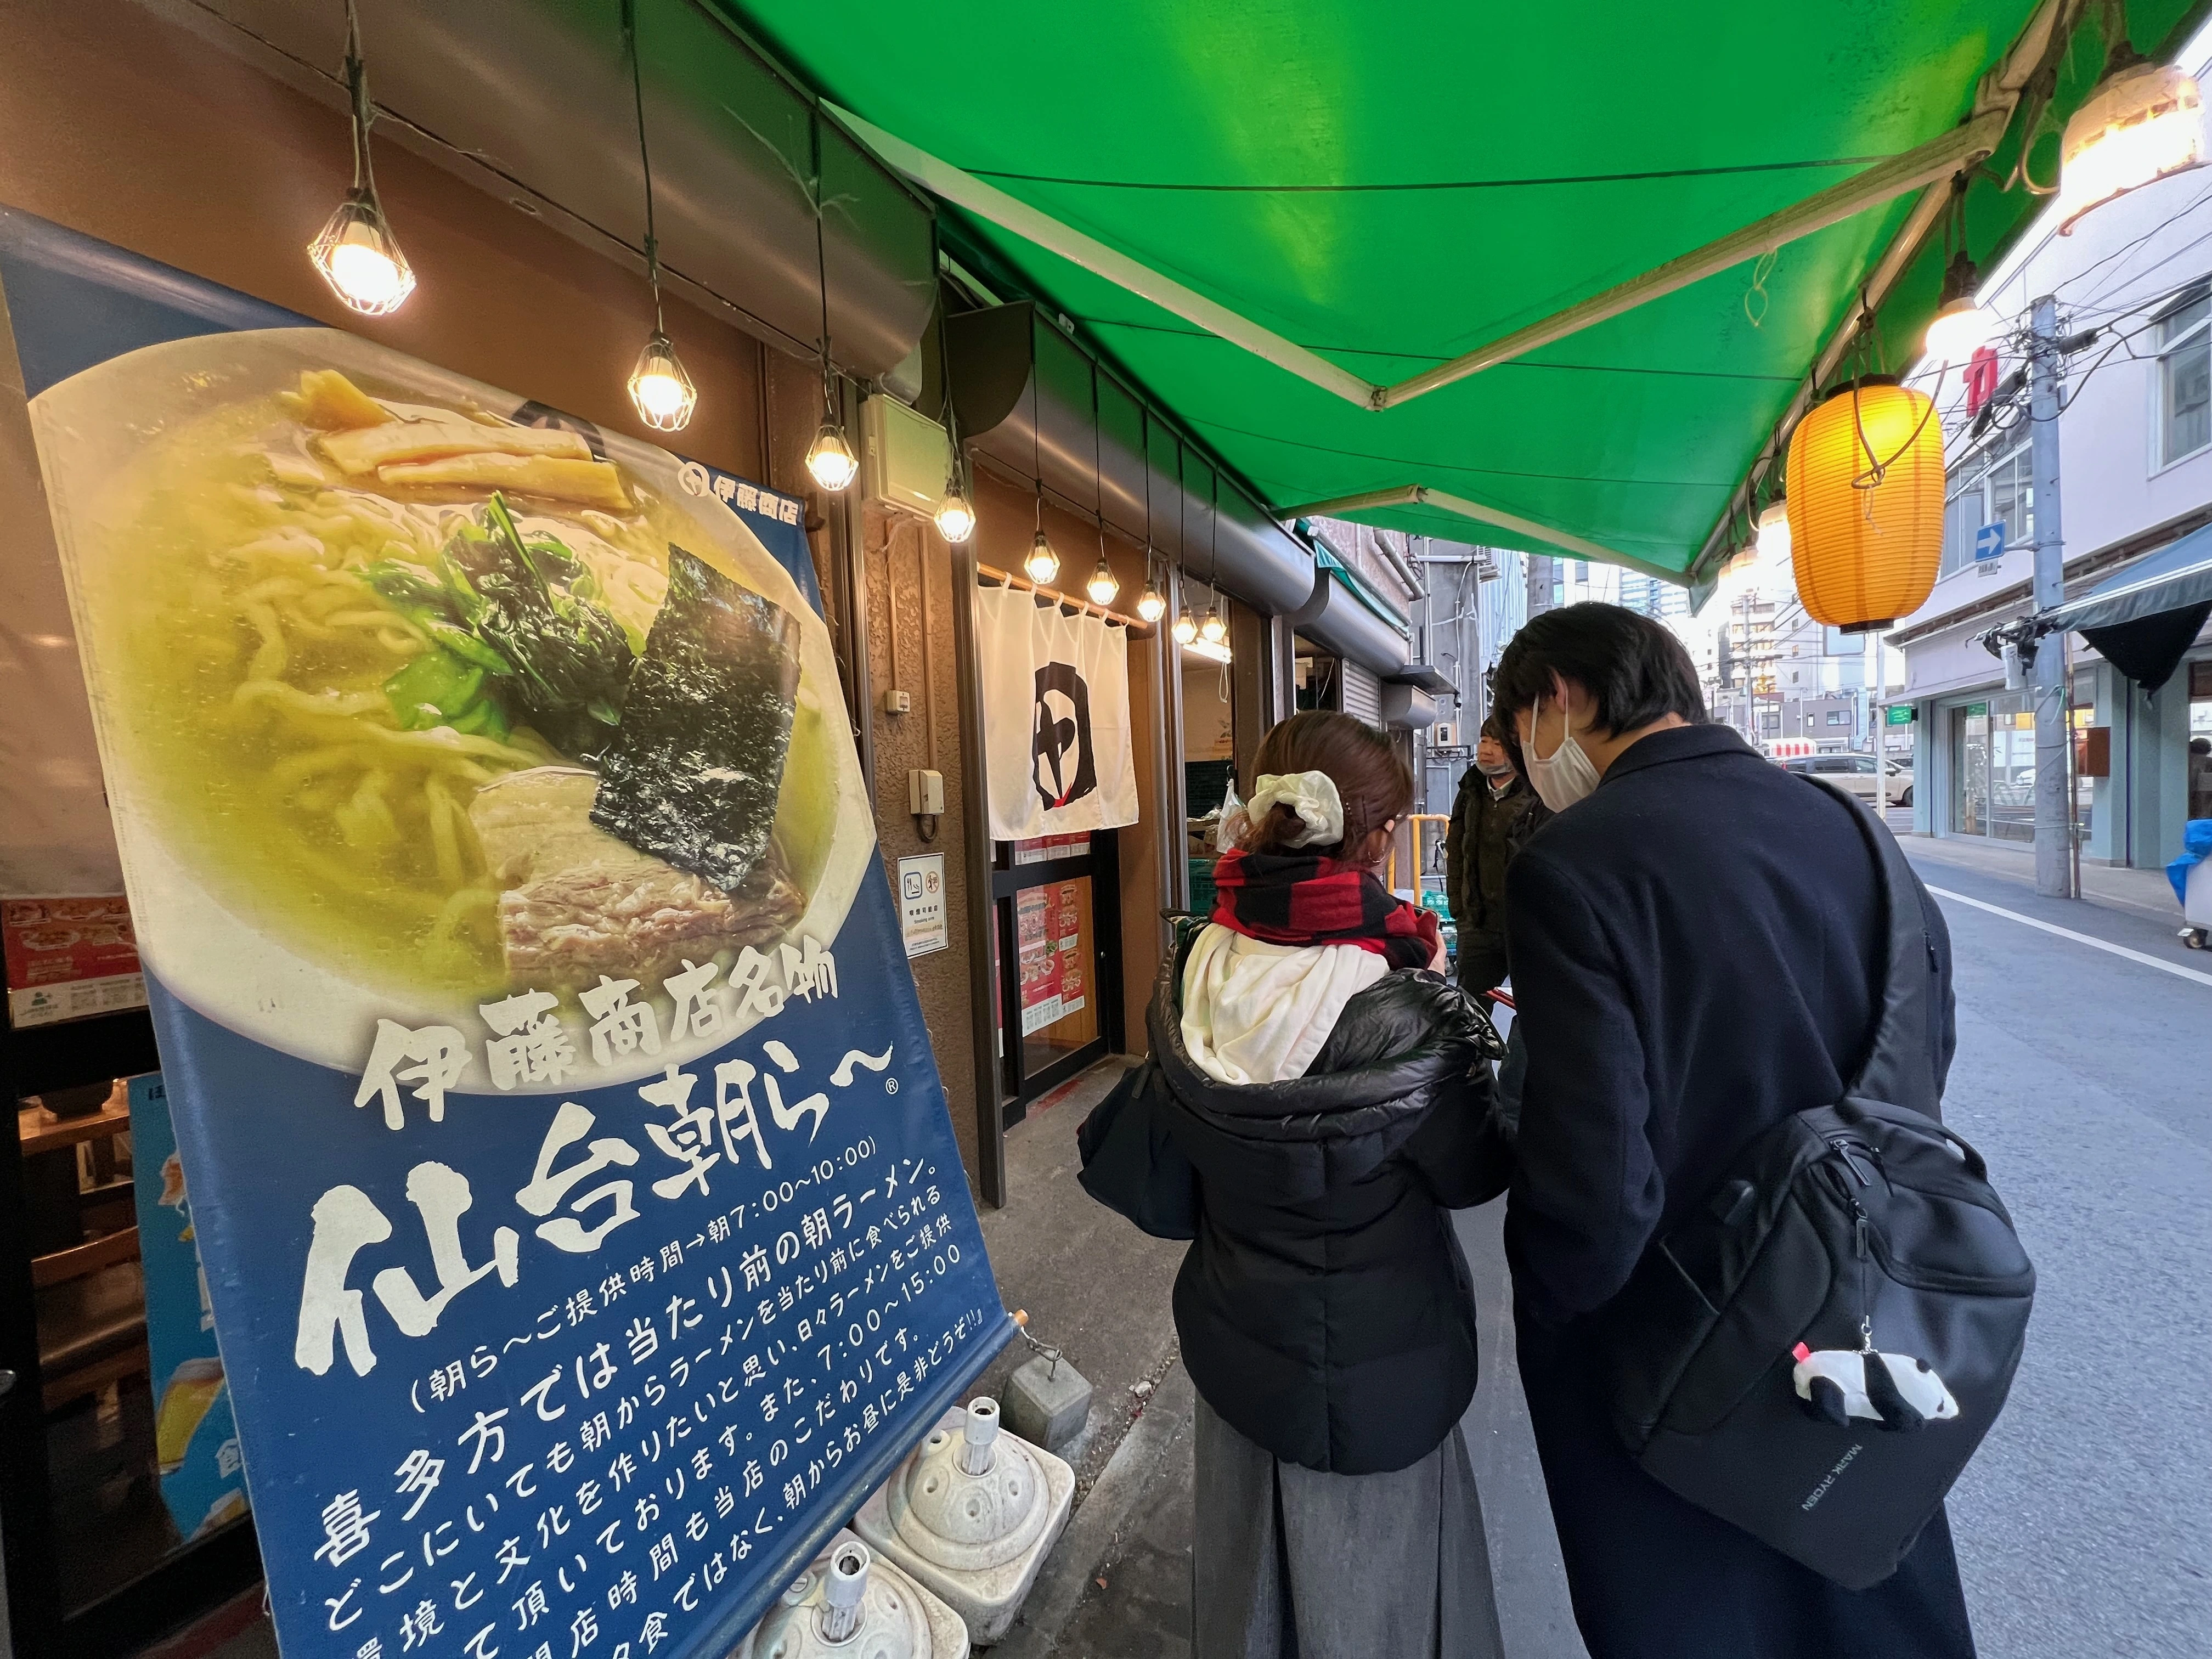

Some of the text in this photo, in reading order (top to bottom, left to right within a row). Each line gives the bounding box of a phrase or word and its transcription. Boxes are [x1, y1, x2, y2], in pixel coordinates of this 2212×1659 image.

[714, 475, 799, 526] 伊藤商店
[354, 934, 838, 1130] 伊藤商店名物
[313, 1158, 936, 1567] 喜多方では当たり前の朝ラーメン。
[325, 1185, 940, 1631] どこにいても朝からラーメンを当たり前に食べられる
[1801, 1443, 1863, 1511] MARK RYDEN
